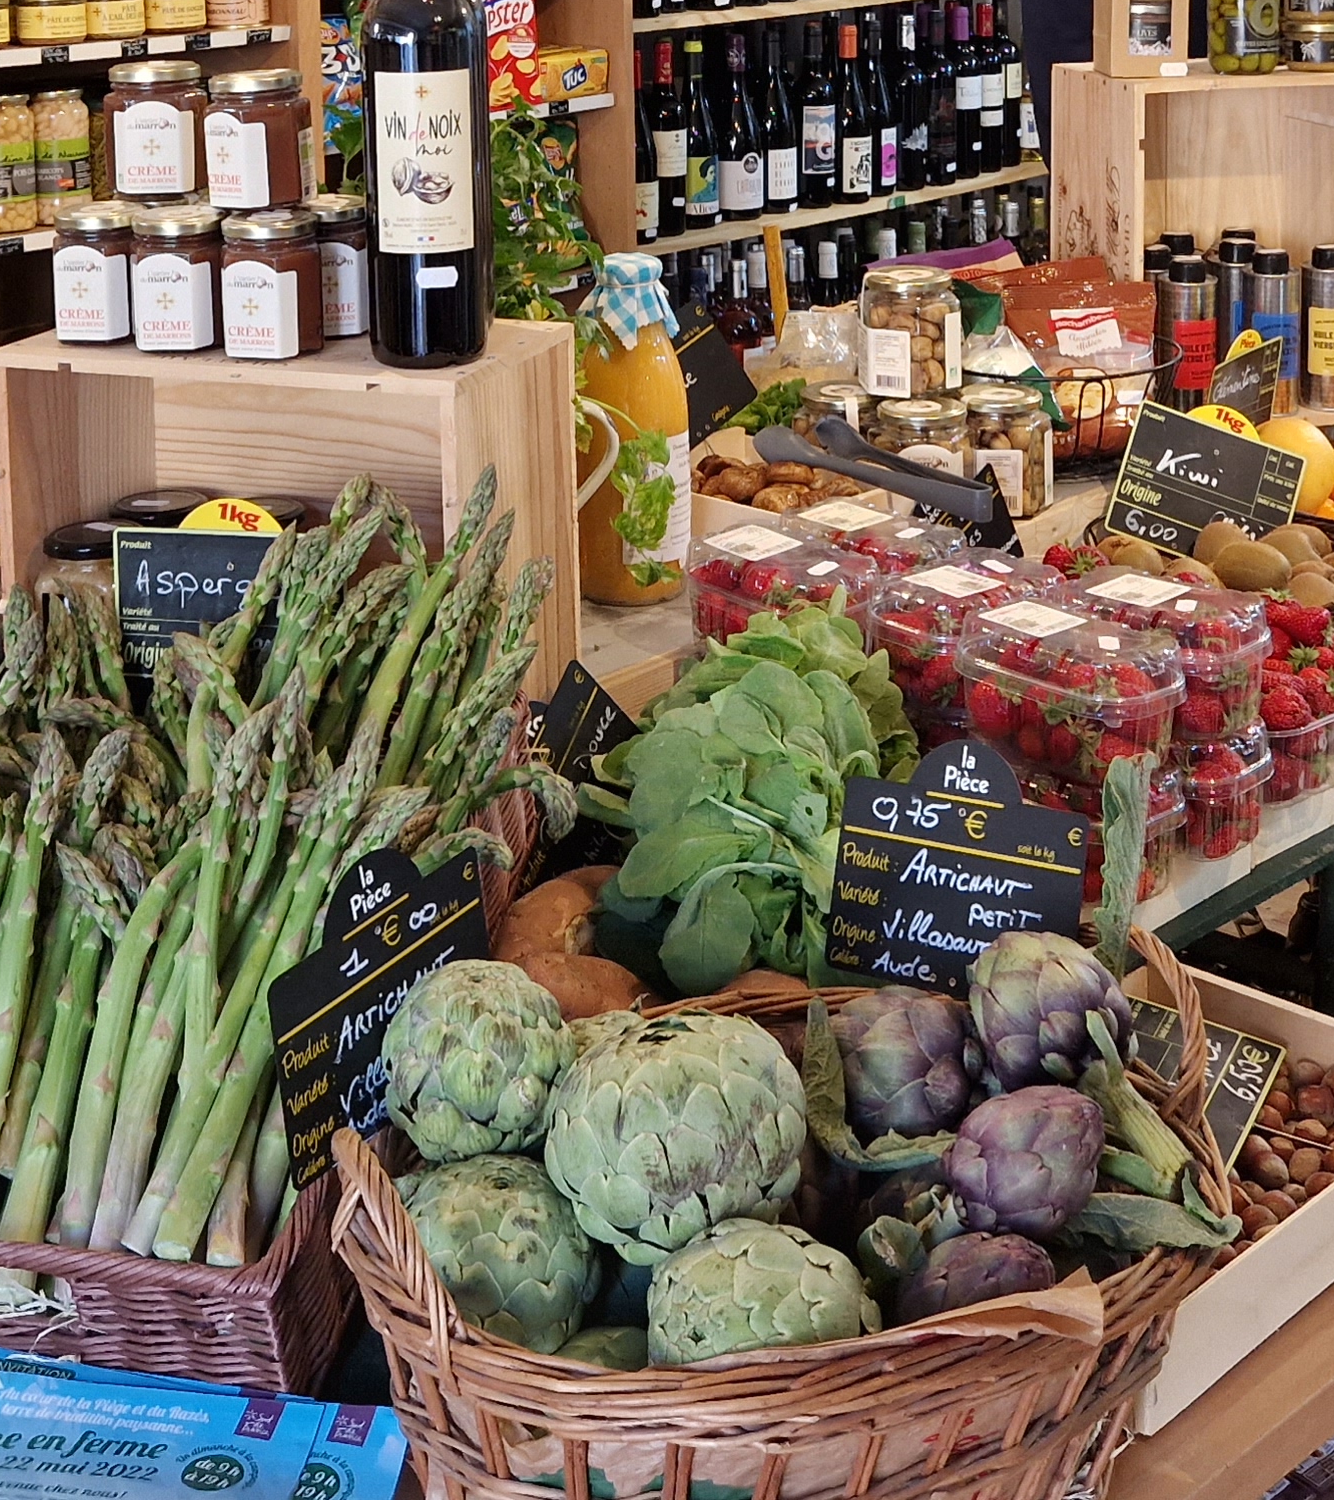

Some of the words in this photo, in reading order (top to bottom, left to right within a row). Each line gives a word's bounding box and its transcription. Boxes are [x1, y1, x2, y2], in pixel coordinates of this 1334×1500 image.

[384, 111, 407, 141] VIN
[407, 111, 428, 143] de
[428, 109, 462, 139] NOIX
[415, 142, 453, 157] moi
[127, 164, 177, 177] CRÈME
[59, 308, 104, 320] CRÈME
[70, 320, 105, 328] MARRONS
[142, 319, 192, 332] CRÈME
[228, 324, 275, 338] CRÈME
[1313, 330, 1333, 340] HUILE
[1142, 409, 1166, 423] Produit
[1215, 407, 1247, 434] 1kg
[1156, 449, 1224, 488] Kiwi
[1120, 478, 1163, 507] Origine
[218, 502, 262, 532] 1kg
[119, 540, 152, 550] Produit
[122, 606, 153, 617] Variété
[123, 622, 146, 632] Traité
[147, 624, 159, 632] au
[961, 745, 976, 770] la
[944, 765, 990, 795] Pièce
[872, 796, 952, 832] 0,75
[965, 810, 988, 840] €
[842, 841, 891, 872] Produit
[1043, 850, 1055, 862] kg
[358, 864, 375, 888] la
[349, 879, 392, 922] Pièce
[837, 880, 882, 906] Variété
[832, 916, 876, 946] Origine
[281, 1034, 330, 1079] Produit
[286, 1077, 329, 1116] Variété
[292, 1116, 336, 1158] Origine
[27, 1432, 66, 1452] en
[61, 1430, 169, 1459] ferme
[35, 1460, 90, 1477] mai
[89, 1460, 159, 1482] 2022
[194, 1458, 215, 1472] de
[42, 1482, 79, 1496] chez
